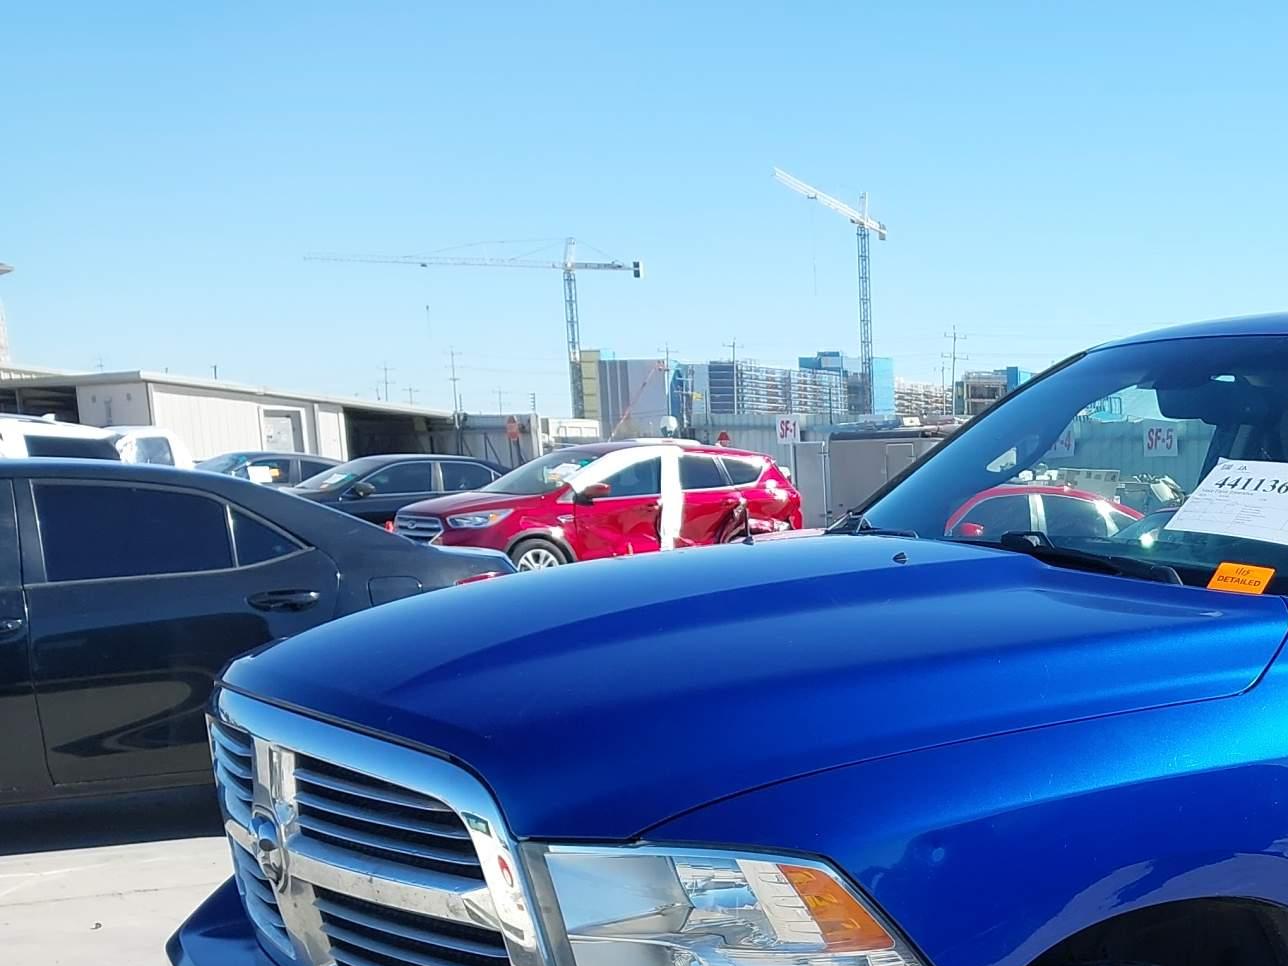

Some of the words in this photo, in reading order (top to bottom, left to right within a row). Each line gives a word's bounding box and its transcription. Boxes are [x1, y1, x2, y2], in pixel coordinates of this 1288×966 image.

[780, 420, 797, 439] SF-1
[1147, 427, 1174, 450] SF-5
[1217, 575, 1261, 587] DETAILED
